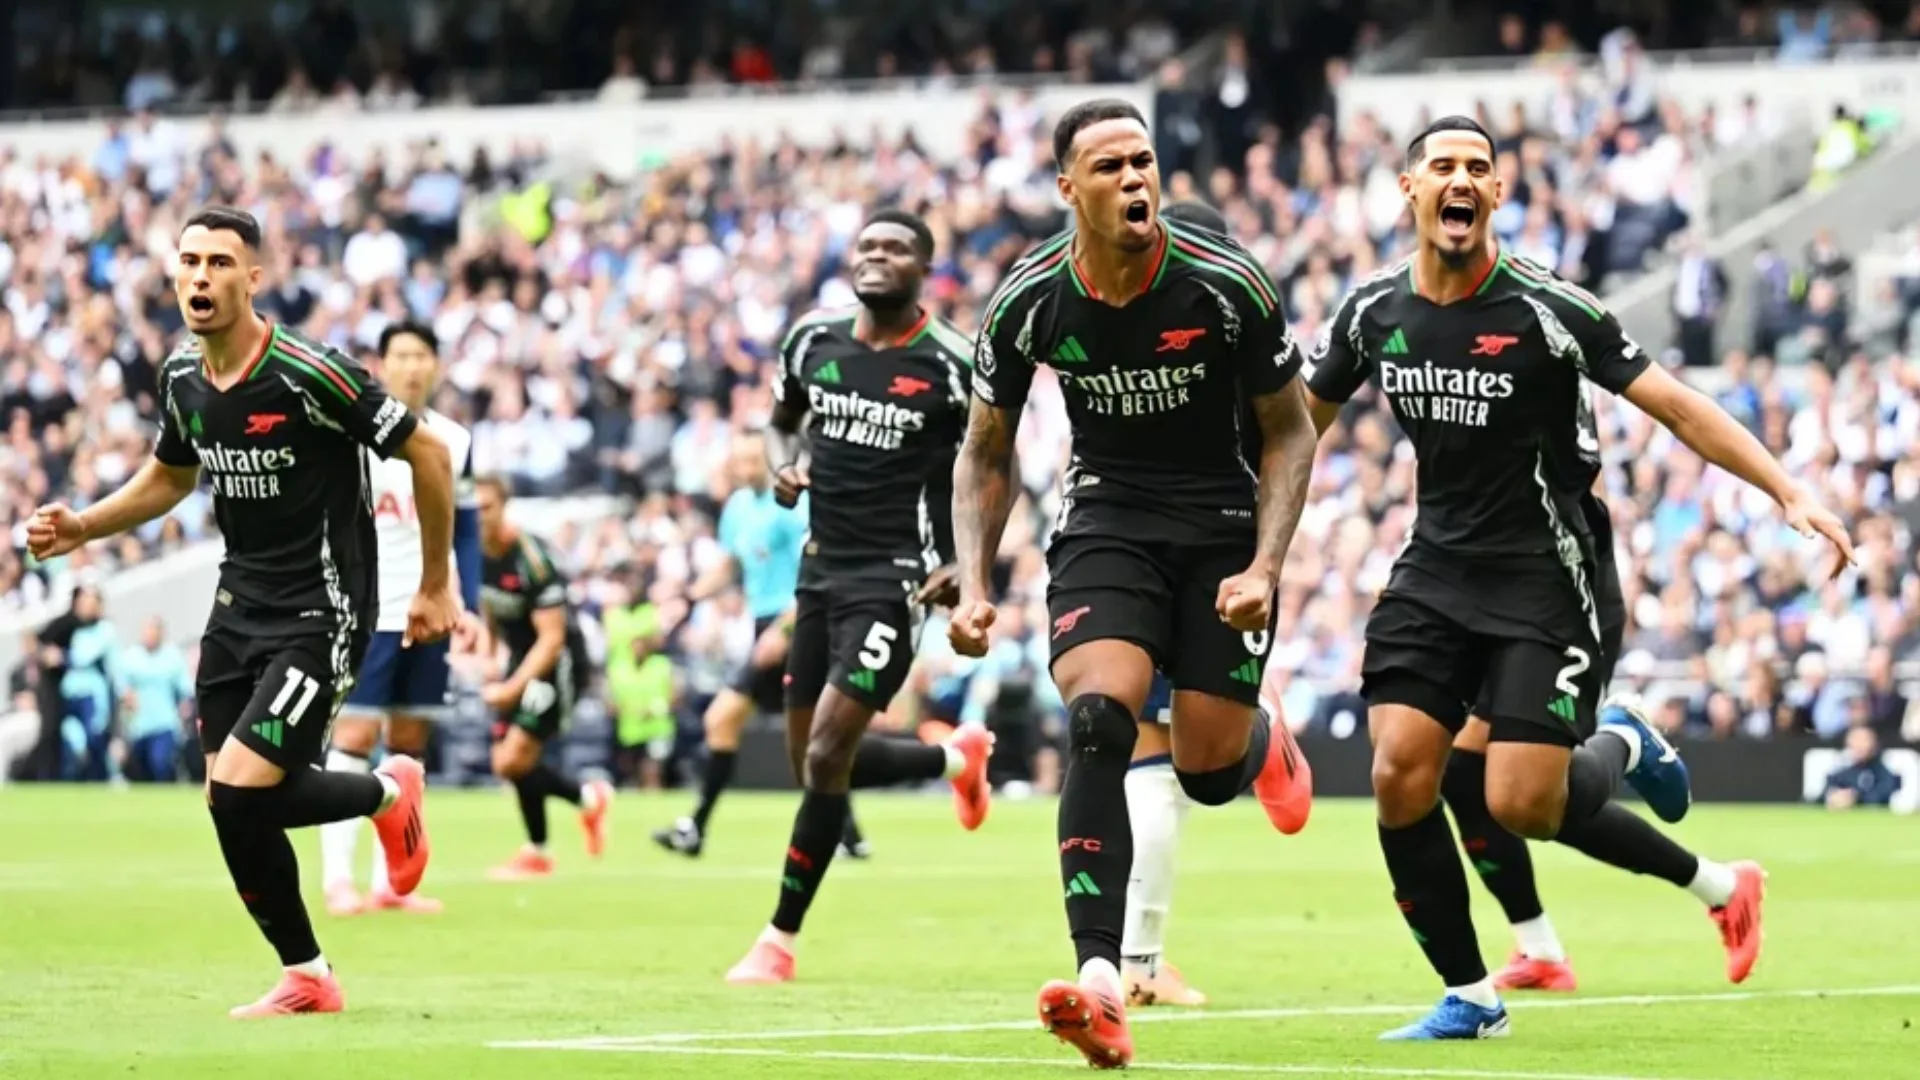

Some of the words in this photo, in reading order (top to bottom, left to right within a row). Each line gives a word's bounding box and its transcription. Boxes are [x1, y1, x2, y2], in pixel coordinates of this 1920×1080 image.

[1379, 359, 1514, 398] Emirates
[808, 384, 926, 431] Emirates
[1122, 387, 1190, 416] BETTER
[1431, 396, 1489, 427] BETTER
[224, 474, 281, 500] BETTER
[857, 620, 899, 671] 5
[1555, 645, 1591, 699] 2
[268, 665, 320, 727] 11
